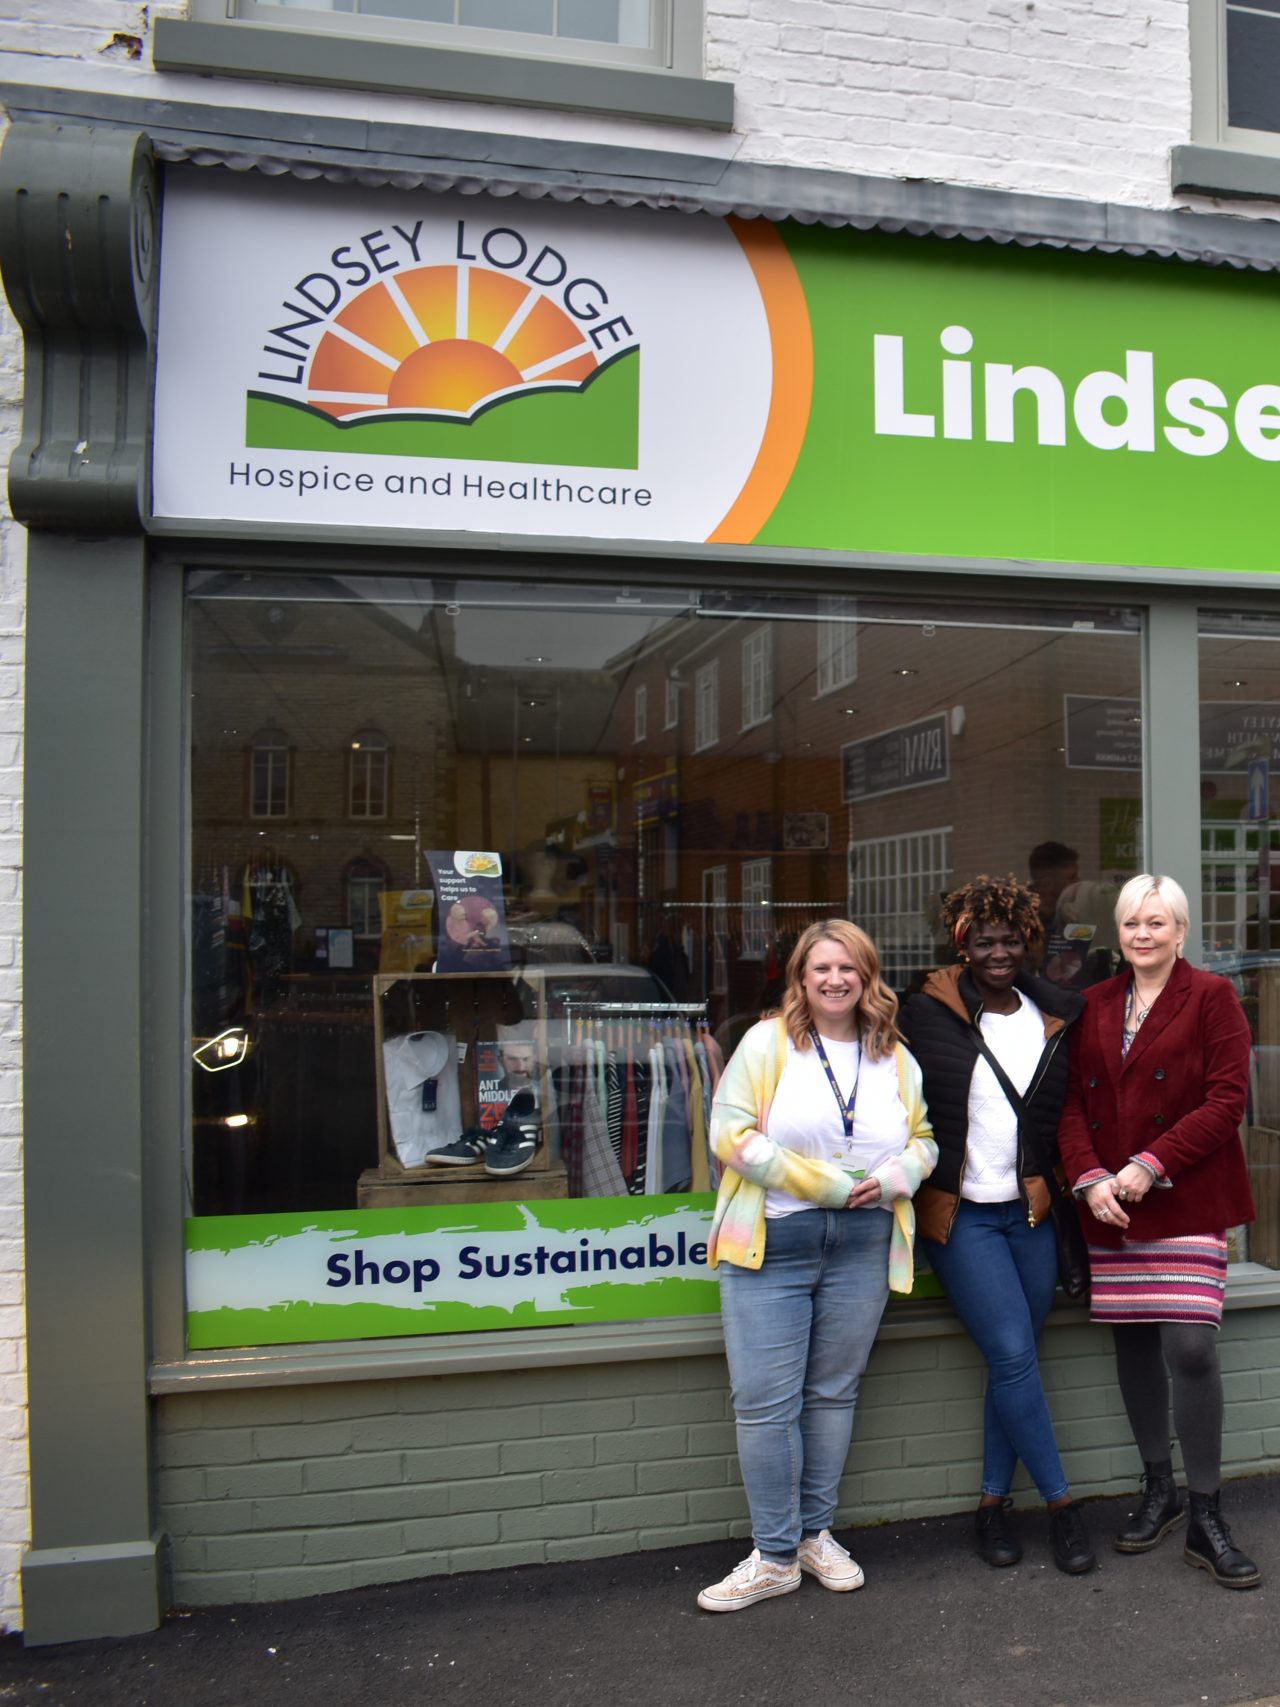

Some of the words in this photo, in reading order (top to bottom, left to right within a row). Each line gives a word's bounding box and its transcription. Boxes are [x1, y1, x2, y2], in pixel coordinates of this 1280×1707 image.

[258, 221, 423, 383] LINDSEY
[456, 220, 633, 349] LODGE
[229, 462, 374, 496] Hospice
[384, 472, 452, 497] and
[463, 475, 653, 507] Healthcare
[439, 877, 466, 886] support
[440, 886, 459, 894] helps
[479, 1079, 500, 1091] ANT
[325, 1250, 441, 1293] Shop
[458, 1232, 709, 1281] Sustainable
